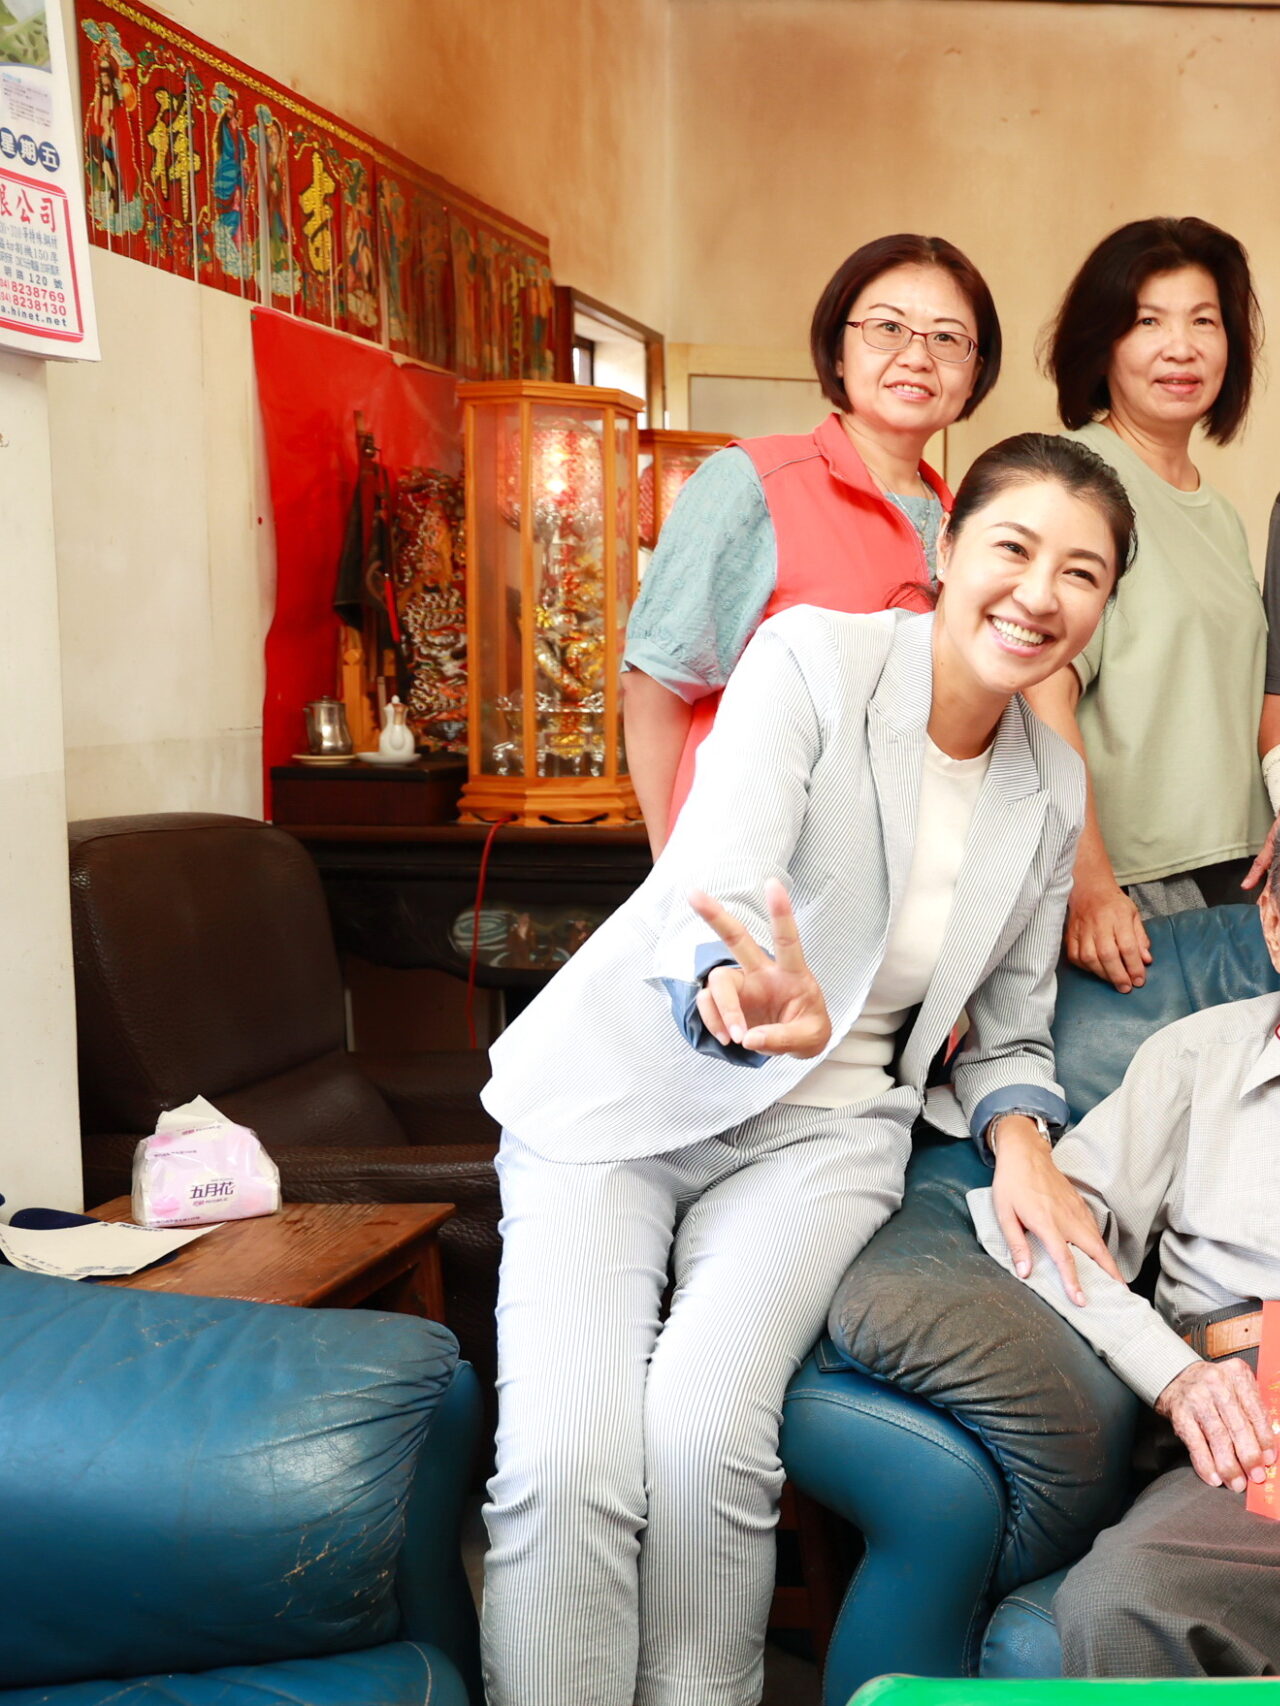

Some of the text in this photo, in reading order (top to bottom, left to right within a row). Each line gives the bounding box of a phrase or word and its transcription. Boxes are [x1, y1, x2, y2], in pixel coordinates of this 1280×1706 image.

[0, 128, 60, 172] 星期五
[190, 1181, 235, 1199] 五月花
